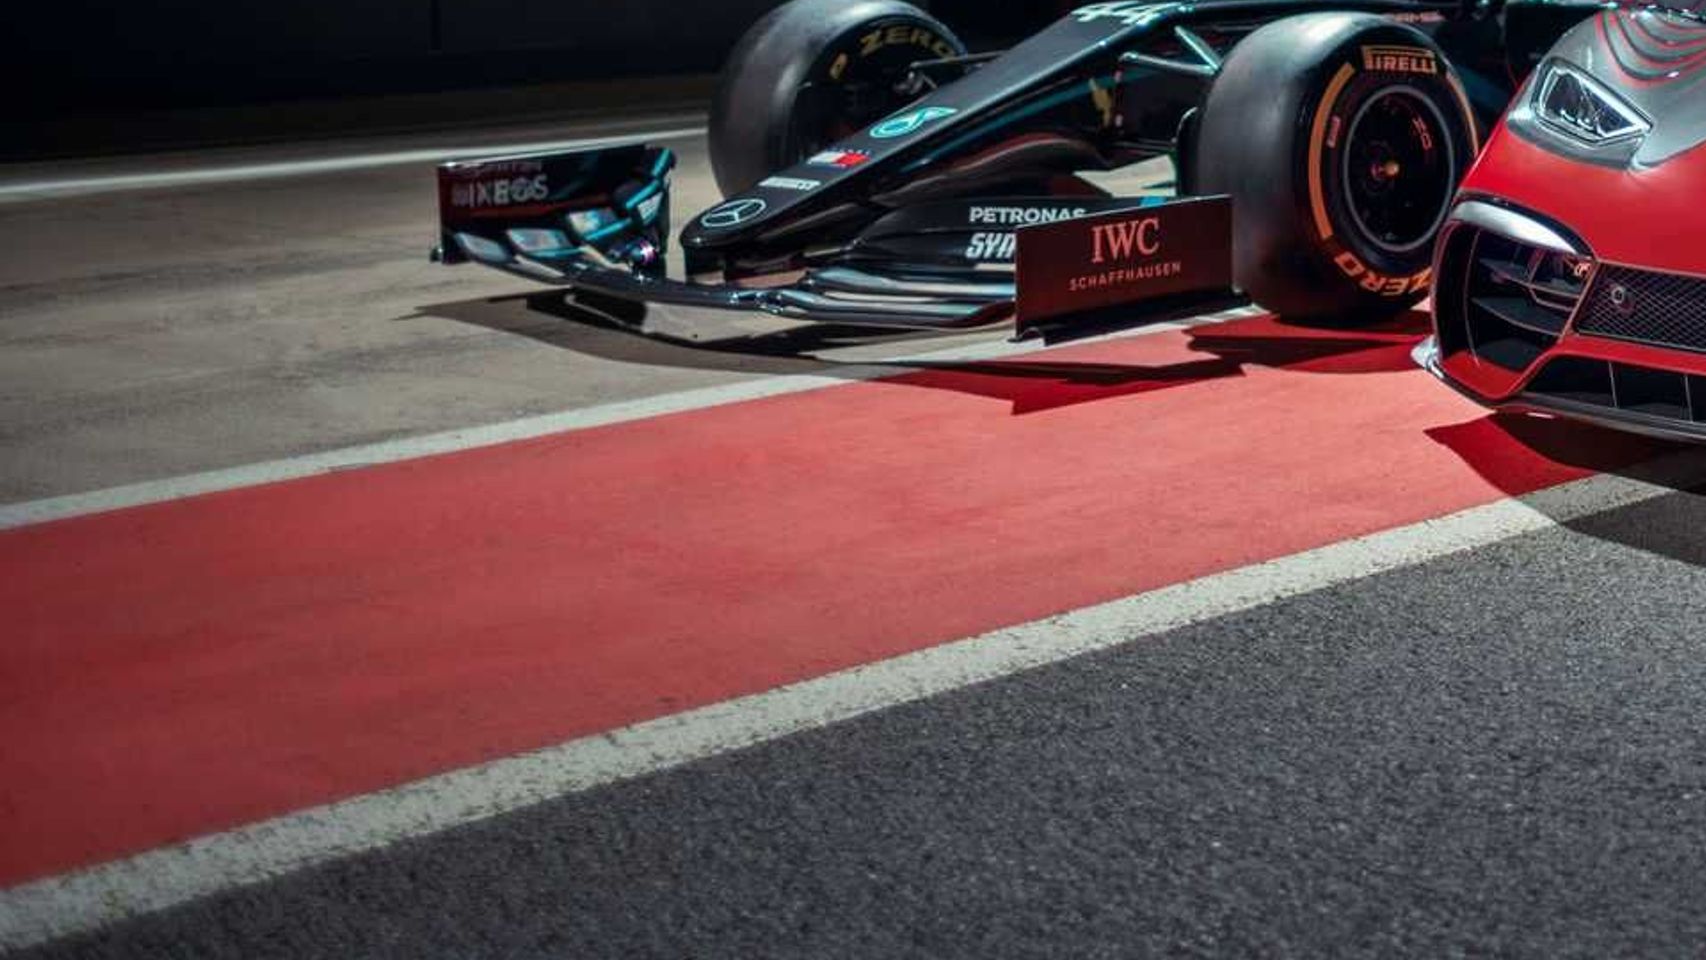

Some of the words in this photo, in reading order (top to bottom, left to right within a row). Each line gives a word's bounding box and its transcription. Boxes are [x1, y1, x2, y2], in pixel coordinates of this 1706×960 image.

[1362, 45, 1438, 74] PIRELLI
[969, 206, 1087, 225] PETRONAS
[1091, 218, 1160, 264] IWC
[1068, 261, 1182, 291] SCHAFFHAUSEN
